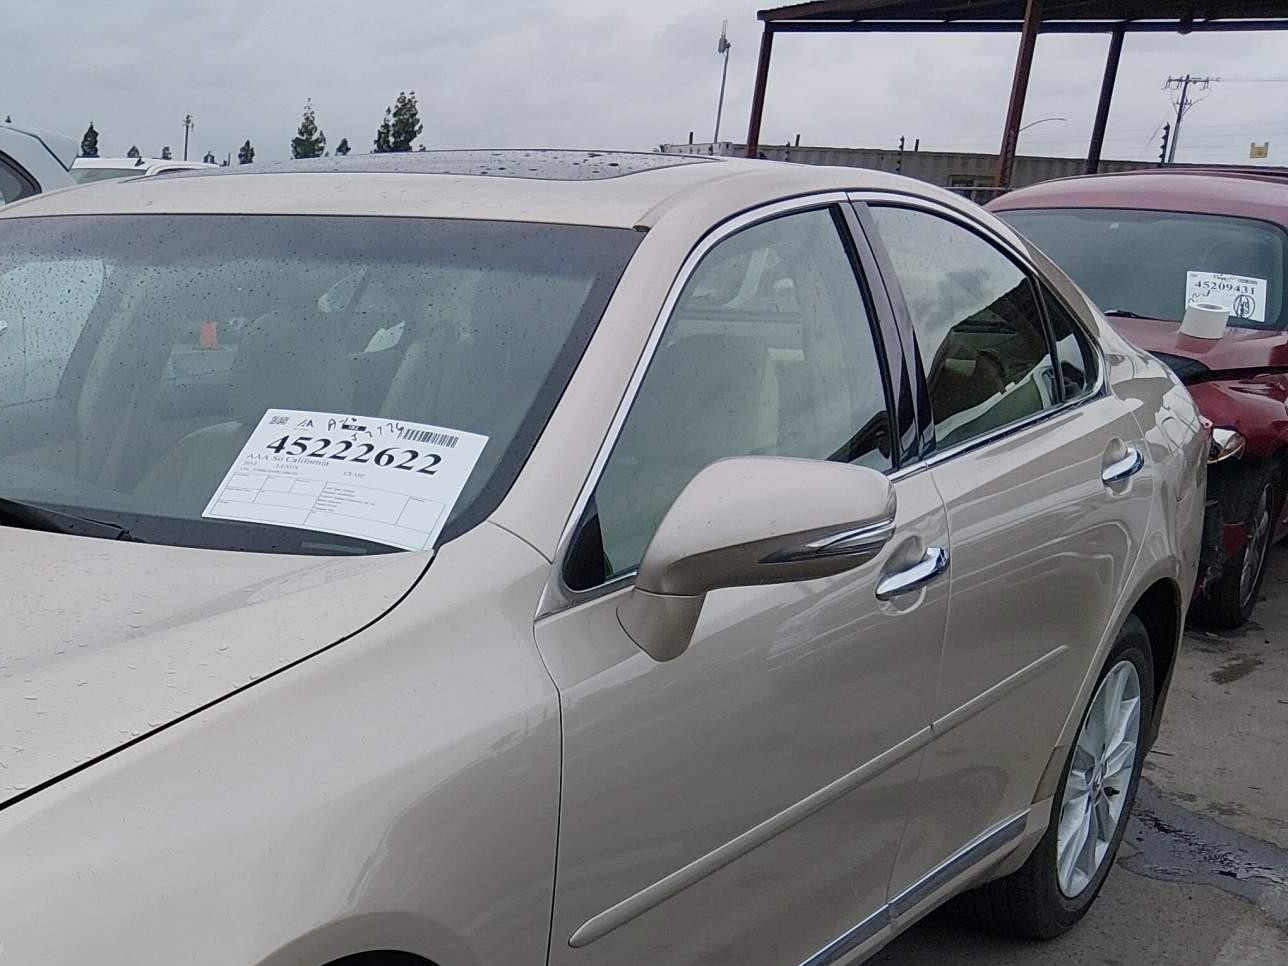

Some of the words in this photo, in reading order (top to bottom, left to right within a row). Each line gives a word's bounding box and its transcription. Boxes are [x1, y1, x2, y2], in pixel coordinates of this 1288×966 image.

[1194, 281, 1255, 295] 45209431
[266, 434, 443, 476] 45222622
[285, 456, 330, 468] California
